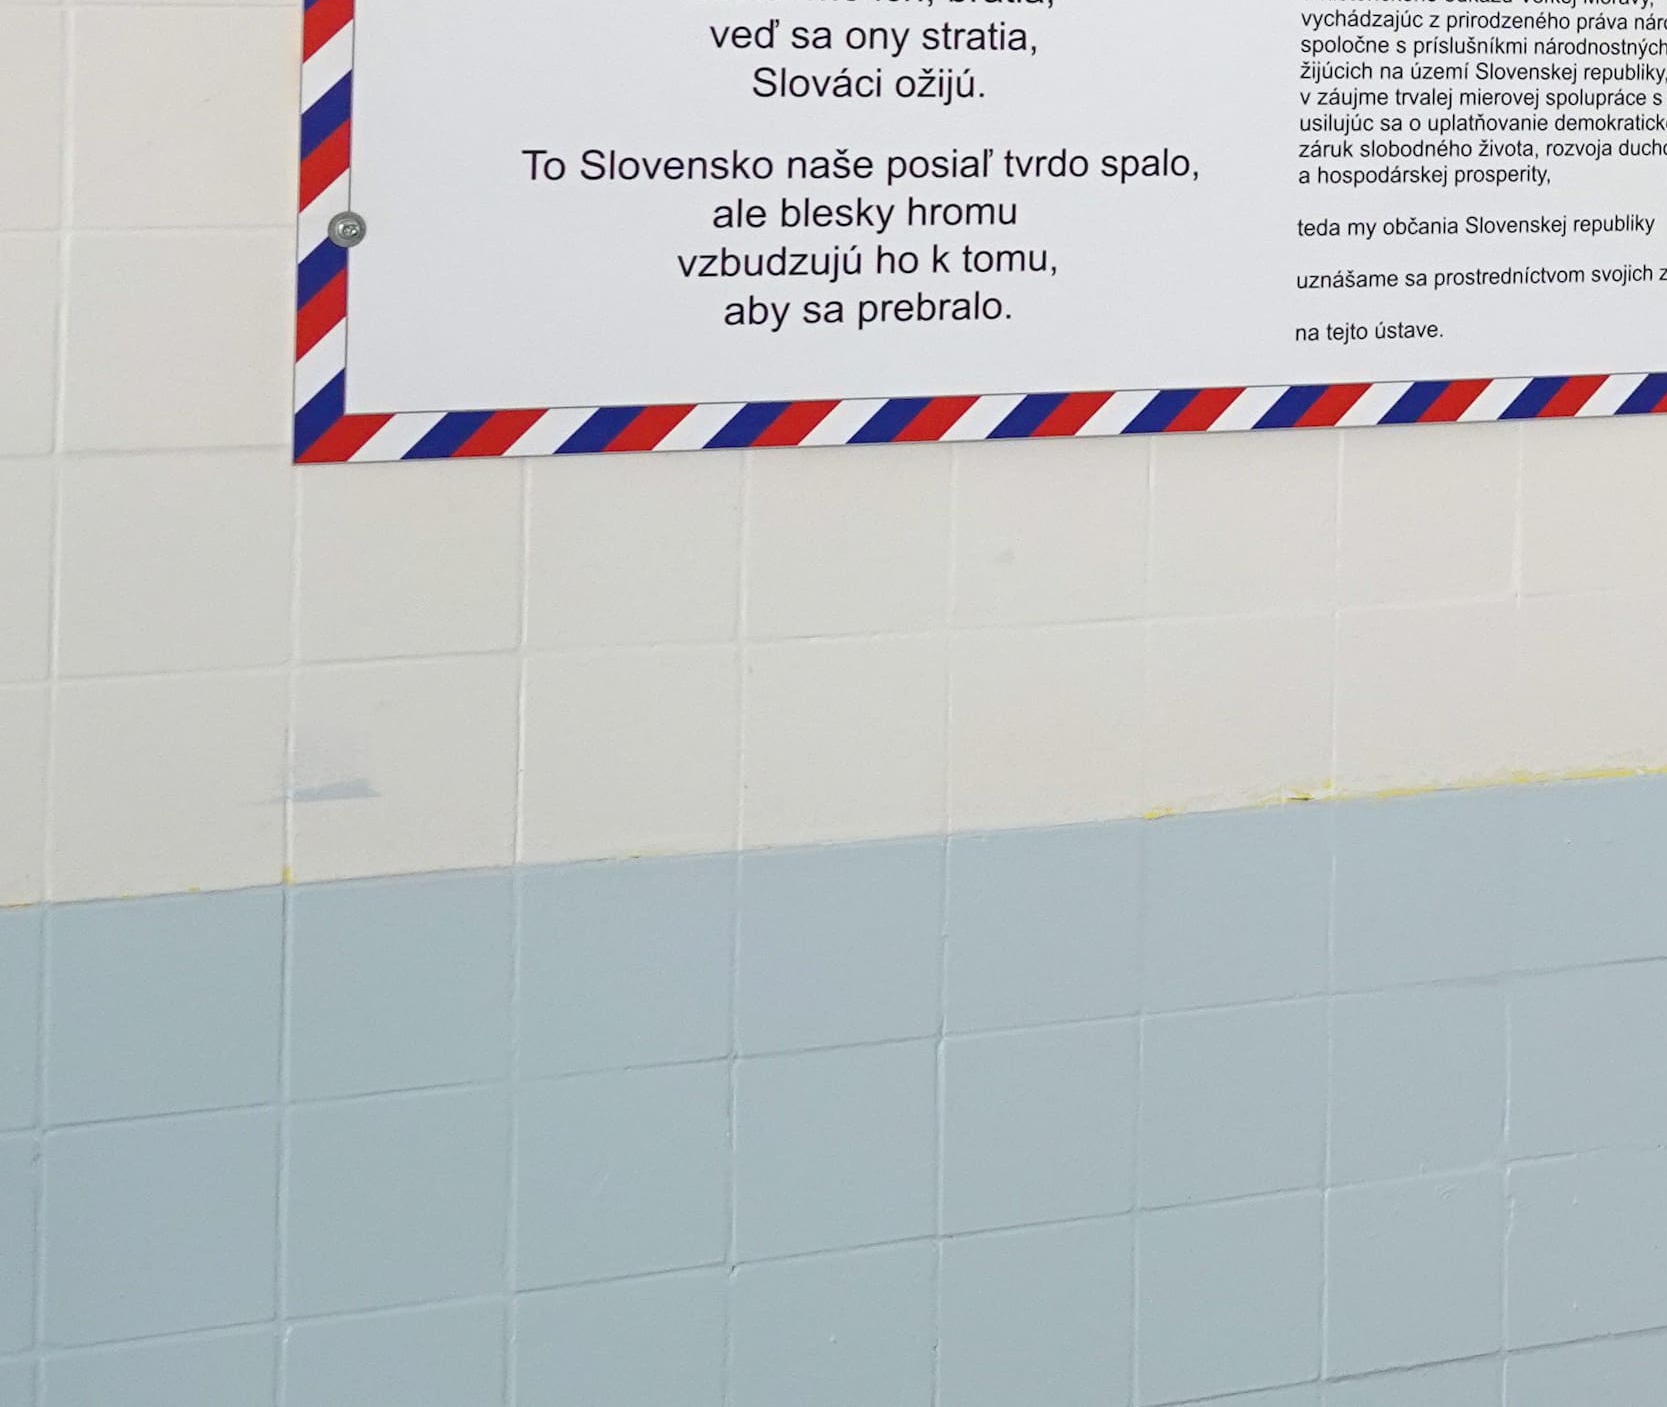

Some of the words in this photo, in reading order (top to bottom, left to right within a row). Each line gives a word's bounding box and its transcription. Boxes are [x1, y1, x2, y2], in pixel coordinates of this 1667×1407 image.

[709, 18, 780, 49] veď
[791, 25, 832, 50] sa
[846, 27, 910, 59] ony
[922, 20, 1036, 56] stratia,
[753, 67, 882, 98] Slováci
[895, 68, 984, 107] ožijú.
[1300, 60, 1372, 84] žijúcich
[1380, 66, 1403, 81] na
[1411, 61, 1469, 81] území
[1476, 61, 1577, 85] Slovenskej
[1584, 62, 1667, 85] republiky,
[521, 149, 566, 181] To
[580, 148, 773, 181] Slovensko
[788, 148, 873, 180] naše
[887, 148, 994, 187] posiaľ
[1004, 148, 1089, 178] tvrdo
[1101, 147, 1198, 184] spalo,
[1298, 139, 1353, 158] záruk
[1360, 139, 1472, 158] slobodného
[1478, 138, 1538, 160] života,
[1546, 138, 1612, 162] rozvoja
[1299, 170, 1310, 185] a
[1318, 164, 1447, 189] hospodárskej
[1455, 164, 1550, 188] prosperity,
[713, 197, 767, 229] ale
[781, 196, 895, 235] blesky
[908, 196, 1016, 227] hromu
[1297, 217, 1340, 237] teda
[1348, 221, 1377, 241] my
[1383, 216, 1458, 236] občania
[1465, 215, 1566, 238] Slovenskej
[1574, 214, 1655, 237] republiky
[677, 244, 861, 284] vzbudzujú
[877, 244, 919, 275] ho
[932, 243, 950, 273] k
[962, 244, 1056, 276] tomu,
[724, 294, 791, 333] aby
[803, 300, 844, 325] sa
[858, 290, 1011, 331] prebralo.
[1296, 327, 1319, 342] na
[1326, 322, 1368, 345] tejto
[1375, 320, 1443, 340] ústave.
